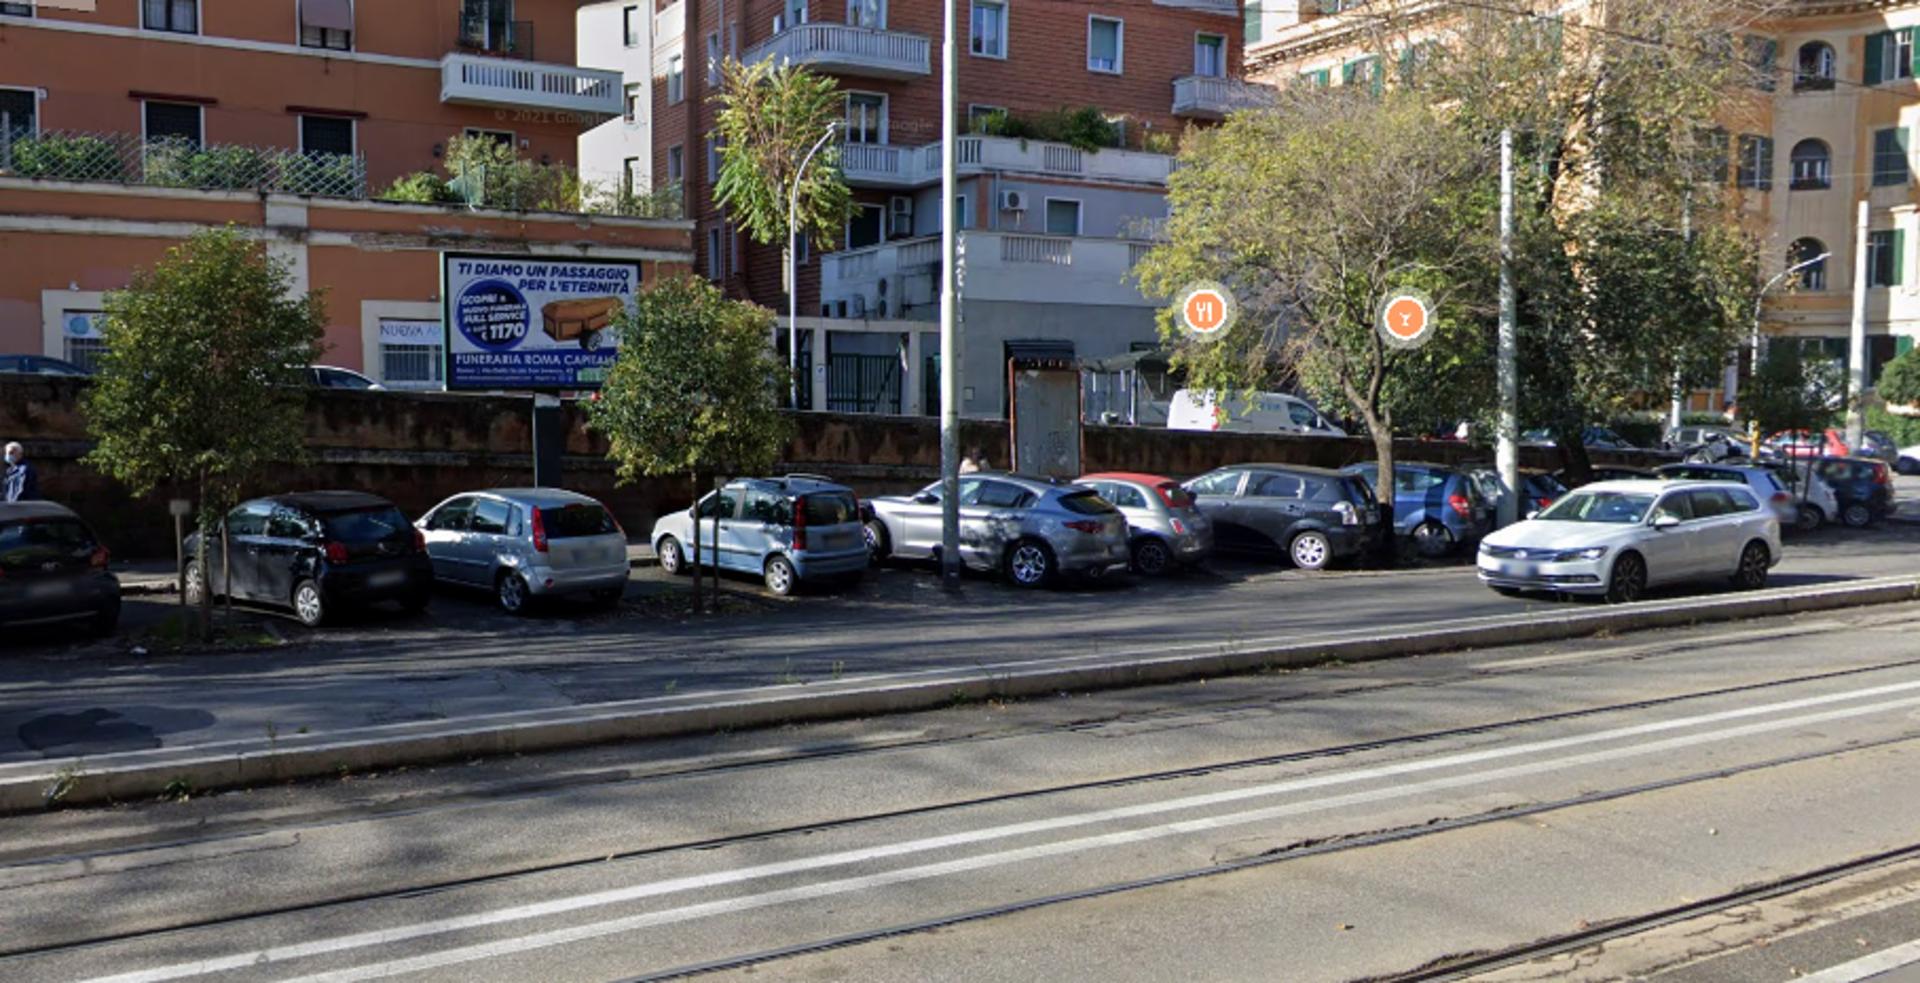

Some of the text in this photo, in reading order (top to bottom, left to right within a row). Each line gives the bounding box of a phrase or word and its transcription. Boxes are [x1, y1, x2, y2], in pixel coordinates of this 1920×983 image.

[458, 262, 630, 281] TI DIAMO UN PASSAGGIO
[518, 279, 548, 291] PER
[490, 322, 526, 339] 1170
[456, 354, 521, 365] FUNERARIA
[525, 354, 561, 365] ROMA
